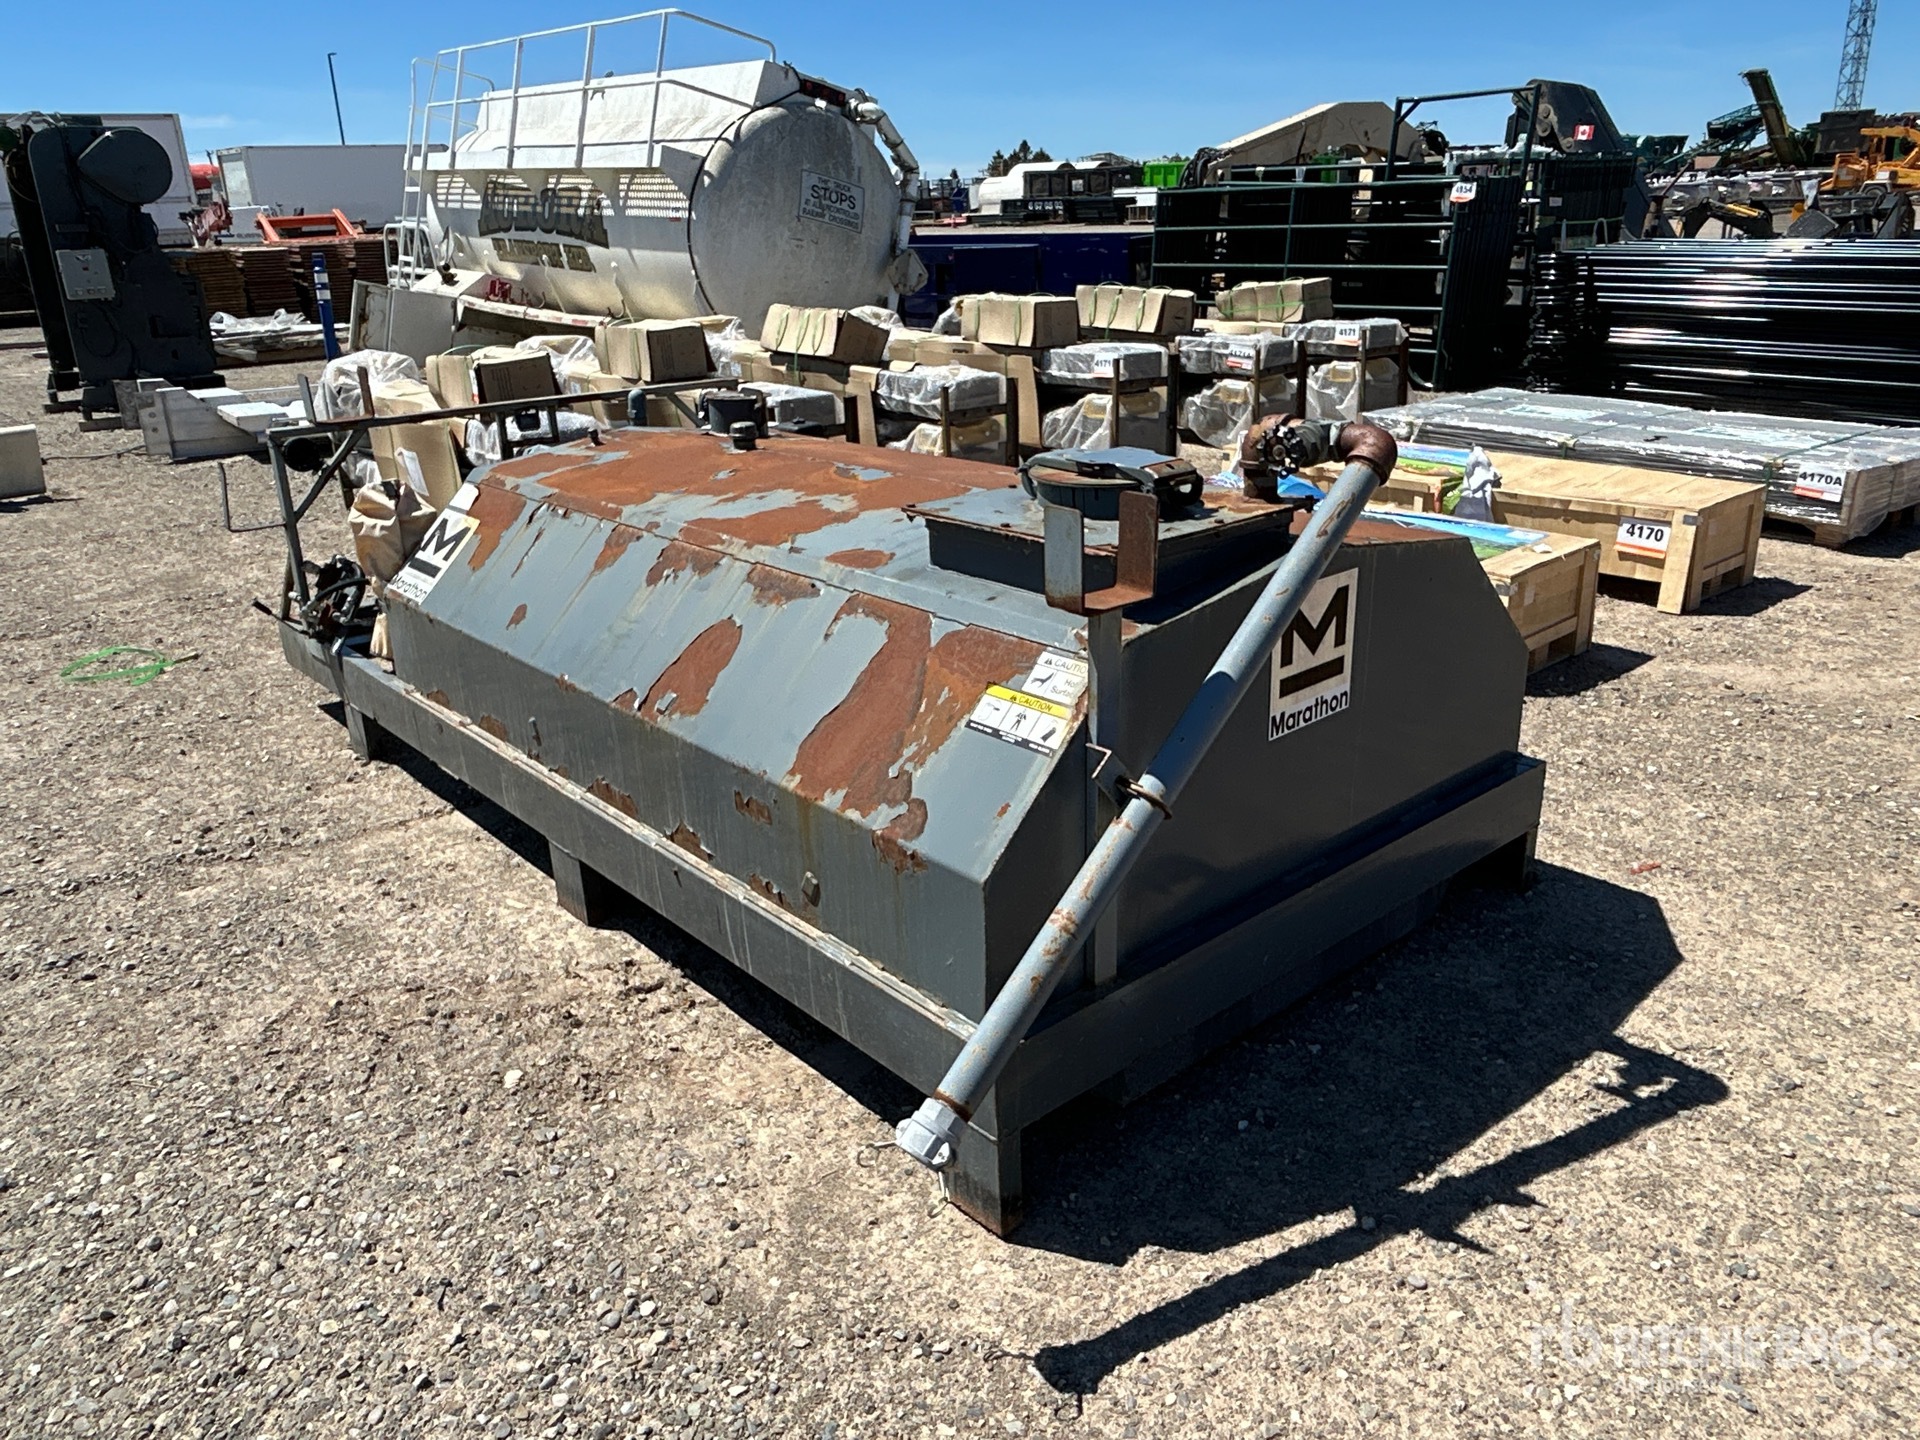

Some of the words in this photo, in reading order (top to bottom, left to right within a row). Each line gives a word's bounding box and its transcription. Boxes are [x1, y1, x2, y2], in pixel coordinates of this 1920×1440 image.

[811, 184, 856, 210] STOPS
[1339, 327, 1356, 336] 4171
[1799, 471, 1843, 487] 4170A
[421, 517, 471, 562] M
[1626, 523, 1664, 542] 4170
[391, 574, 428, 600] Marathon
[1280, 584, 1350, 669] M
[1054, 658, 1088, 674] CAUTIO
[1018, 697, 1053, 712] CAUTION
[1270, 690, 1349, 738] Marathon
